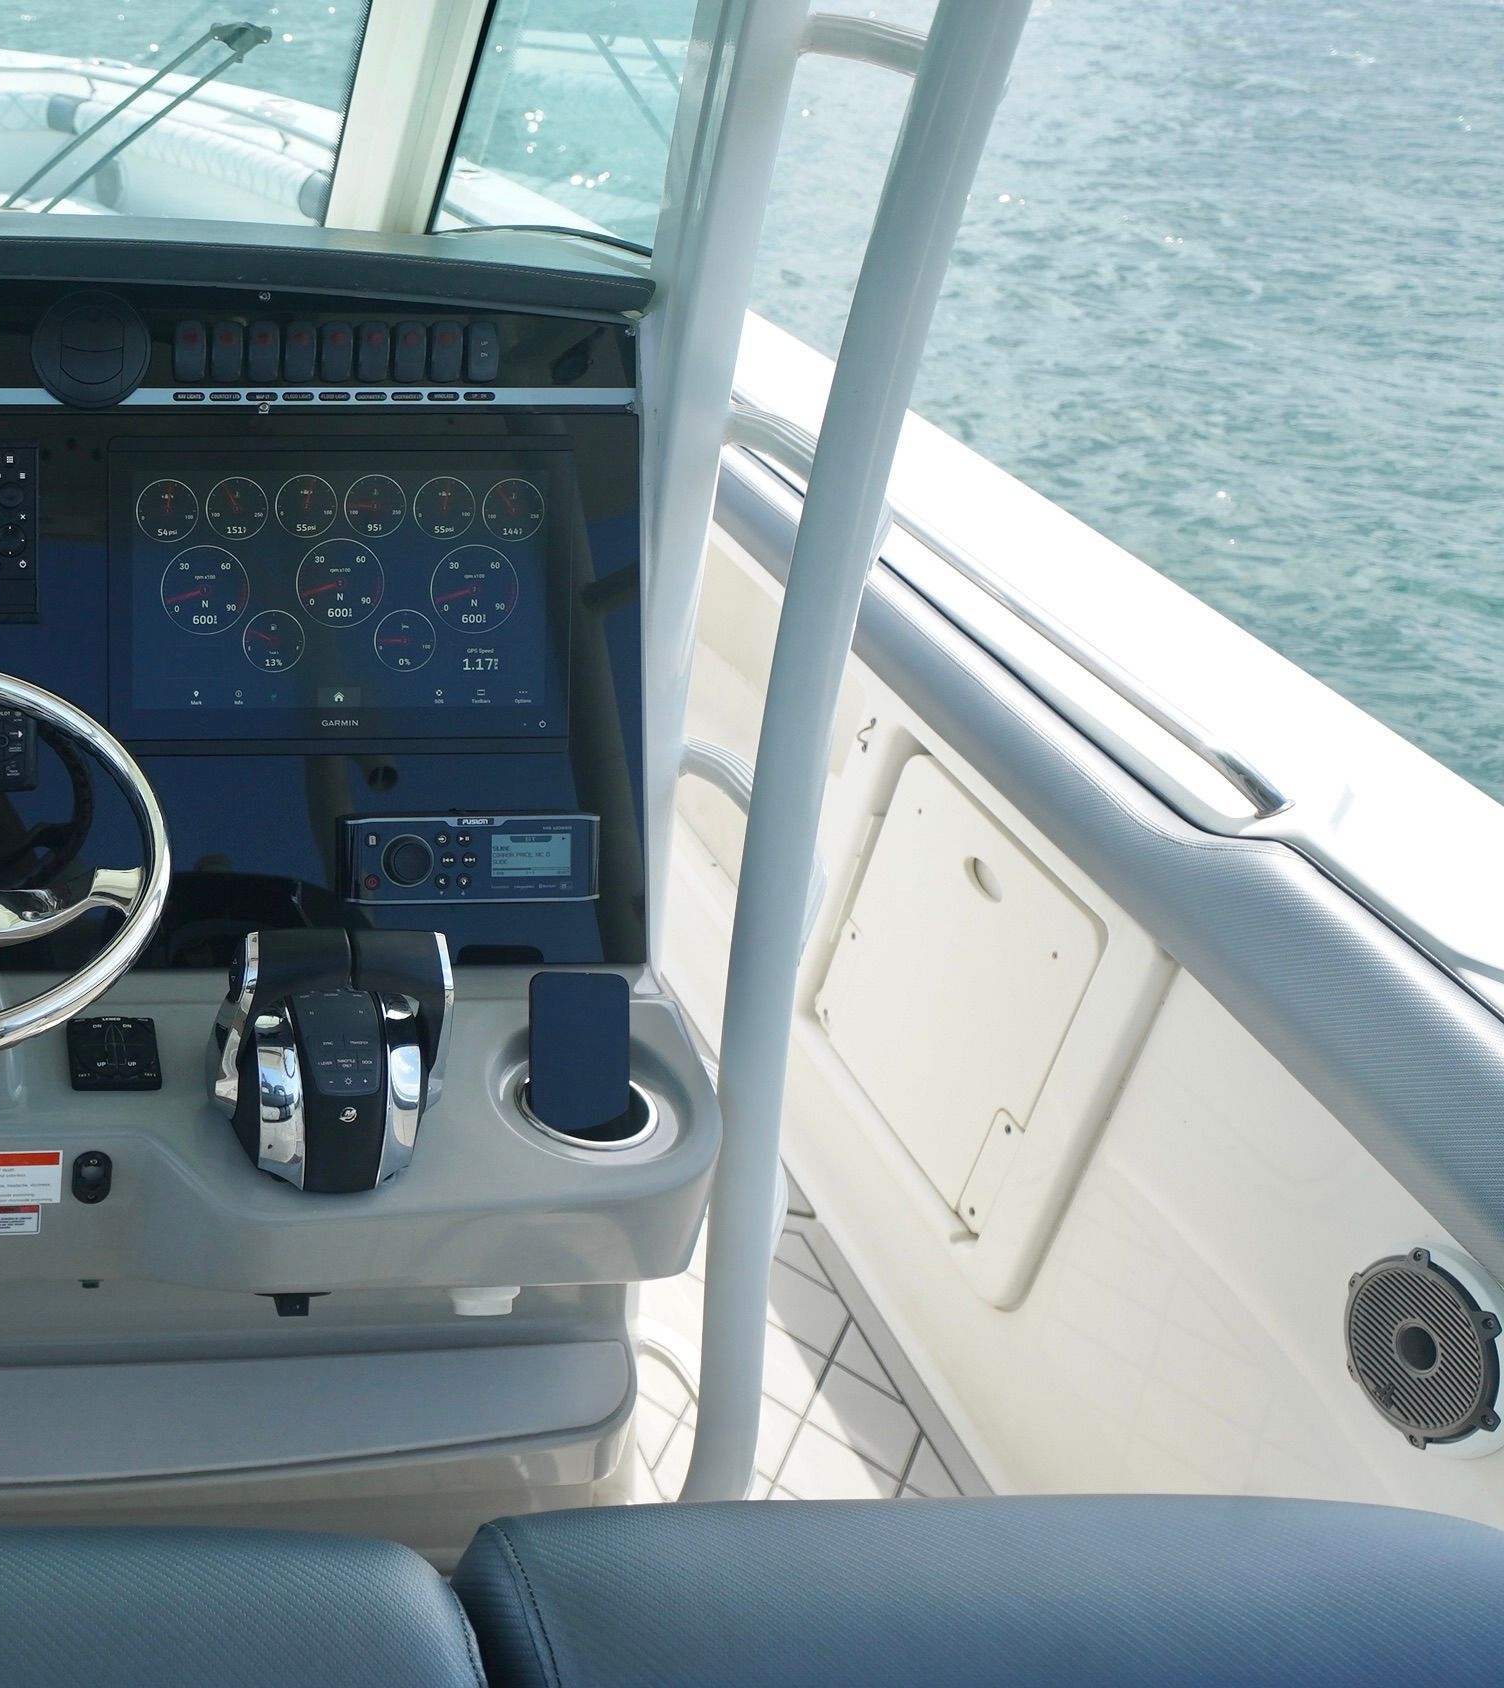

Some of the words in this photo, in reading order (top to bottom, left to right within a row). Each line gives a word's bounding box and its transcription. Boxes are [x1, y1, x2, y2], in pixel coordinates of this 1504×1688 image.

[337, 593, 343, 601] N
[471, 599, 478, 607] N
[443, 604, 449, 612] 0
[327, 608, 348, 617] 600
[192, 615, 213, 625] 600
[461, 614, 482, 623] 600
[265, 659, 282, 667] 13%
[398, 658, 411, 666] 0%
[463, 658, 493, 671] 1.17
